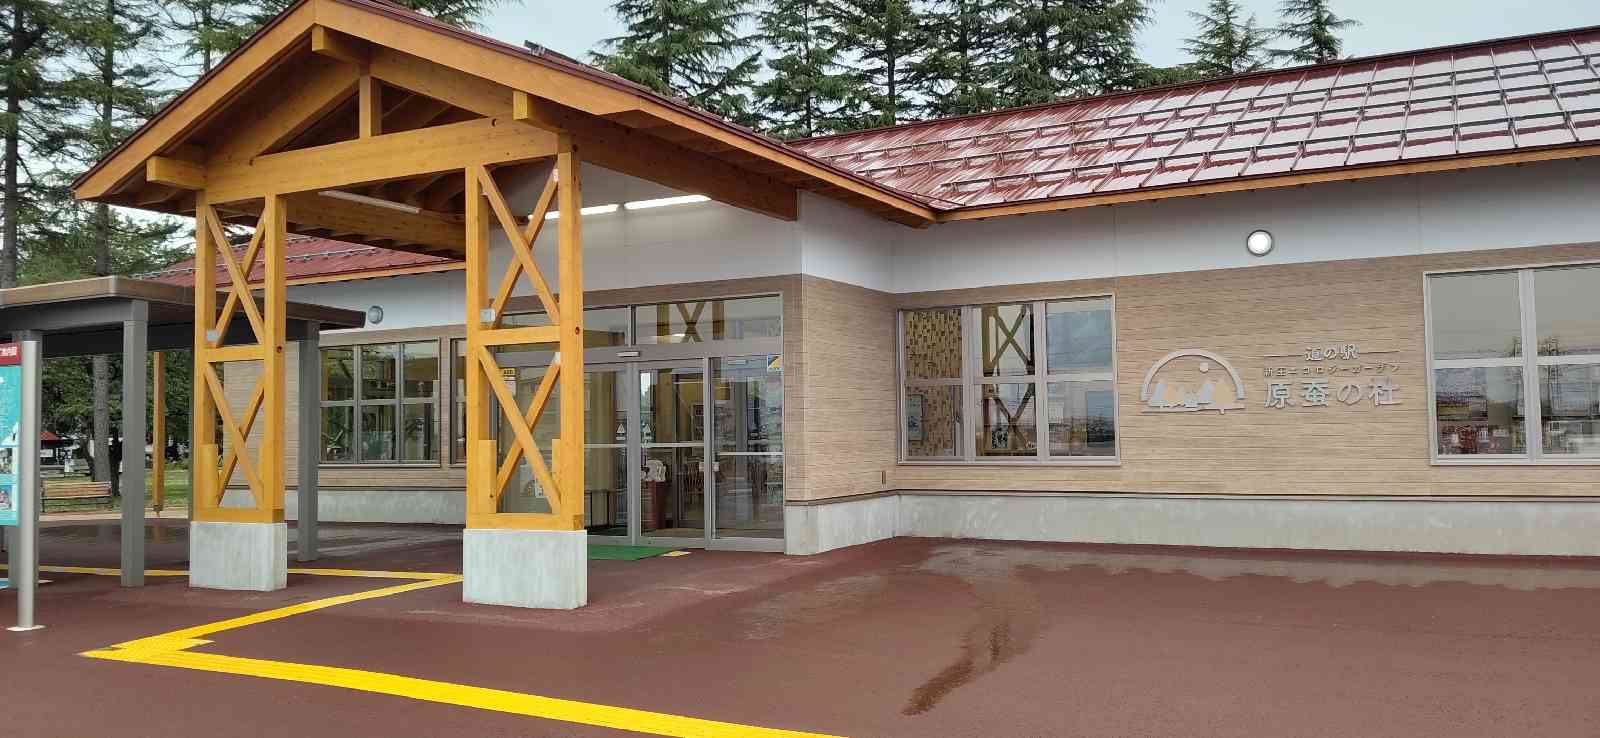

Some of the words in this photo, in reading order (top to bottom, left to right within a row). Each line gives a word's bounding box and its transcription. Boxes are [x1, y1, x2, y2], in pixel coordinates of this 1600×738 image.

[1305, 344, 1359, 361] 道の駅
[1264, 378, 1404, 409] 原蚕の杜
